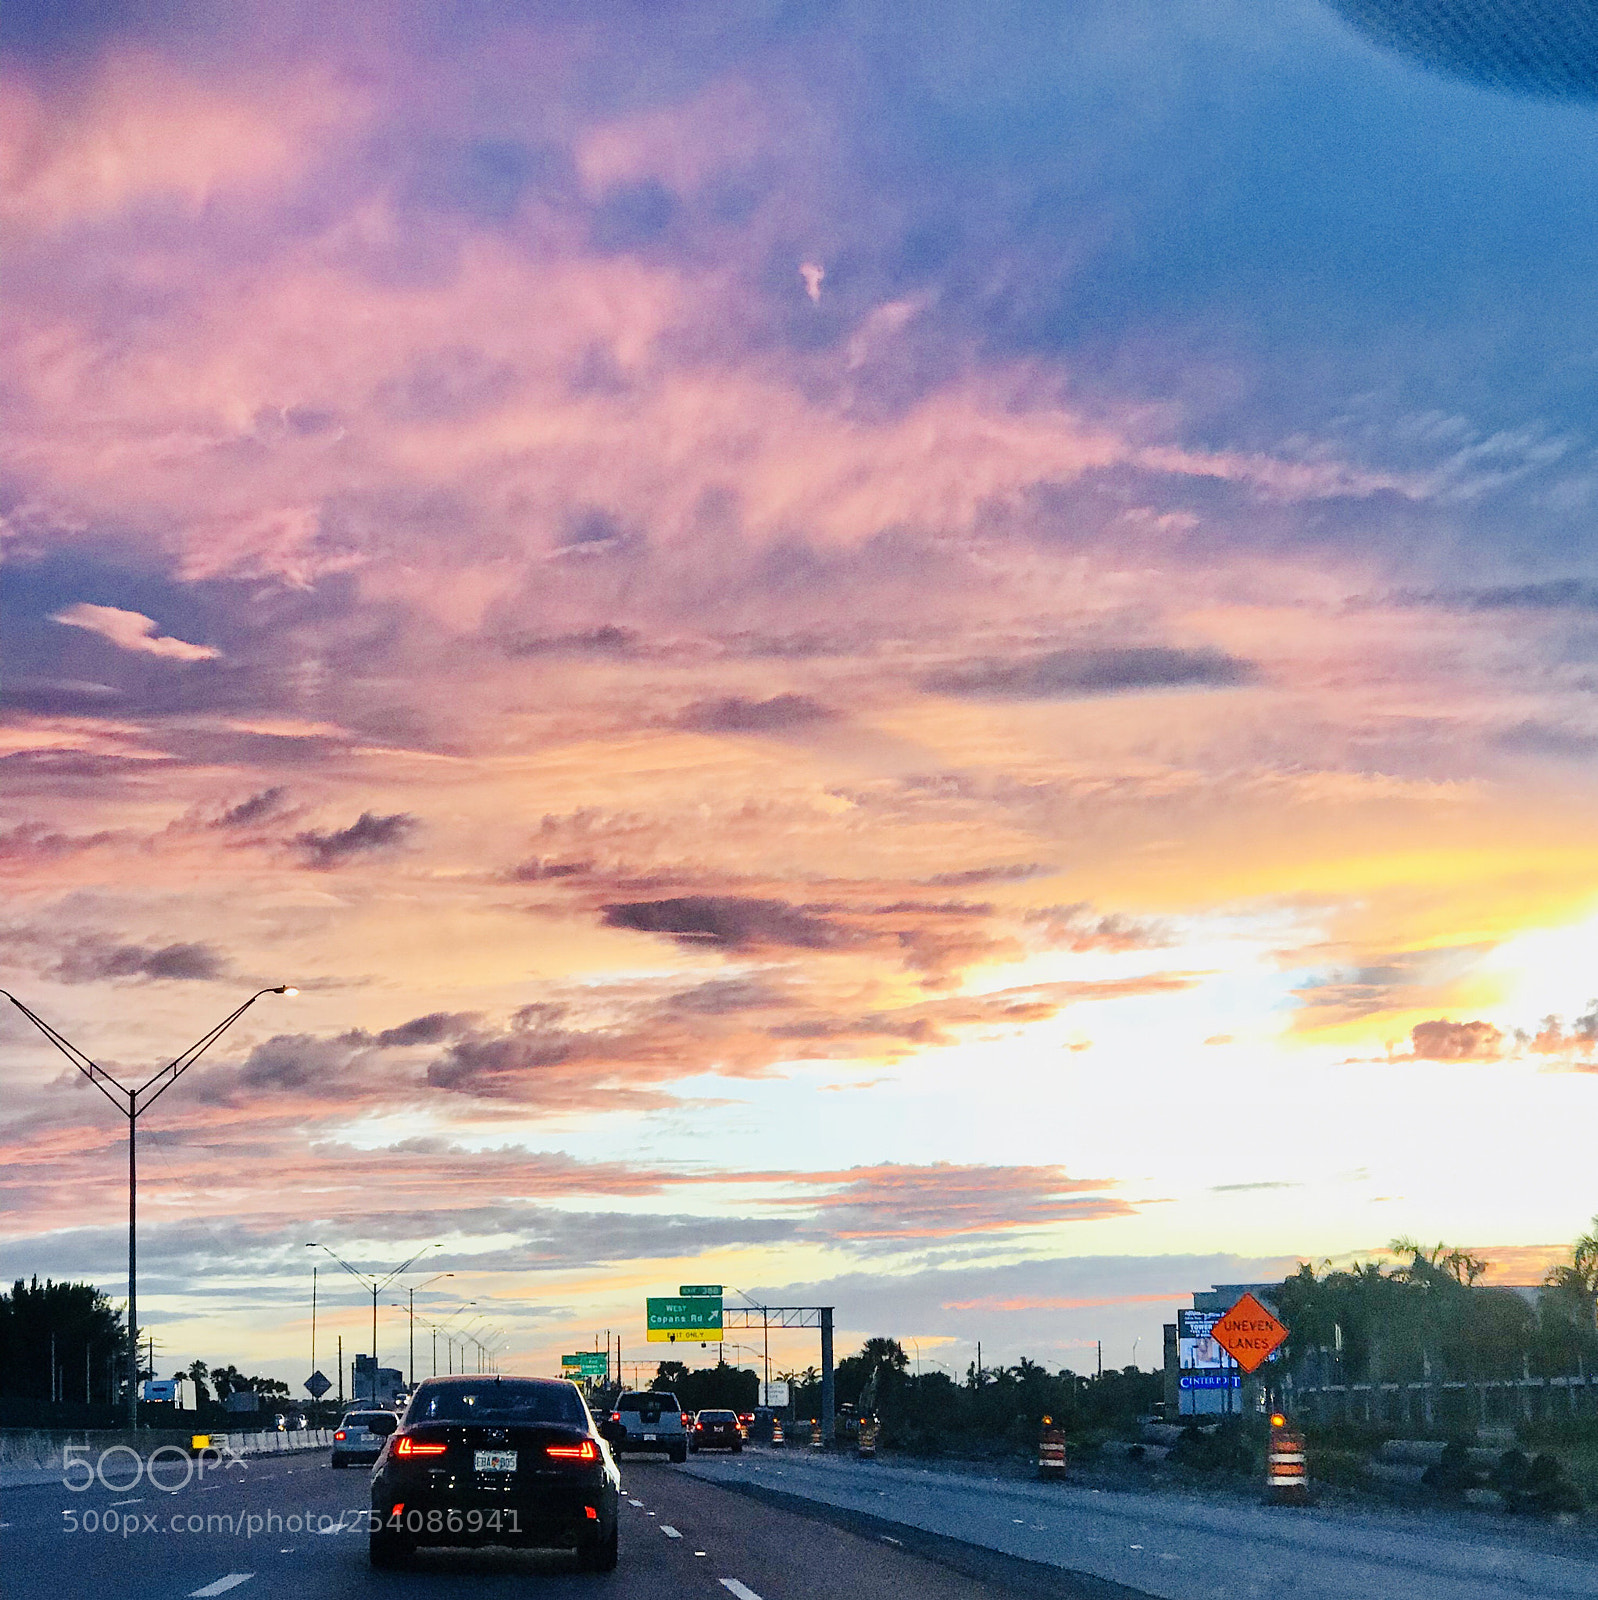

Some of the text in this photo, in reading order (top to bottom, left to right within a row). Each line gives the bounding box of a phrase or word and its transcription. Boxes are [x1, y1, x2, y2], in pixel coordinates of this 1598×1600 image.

[666, 1304, 687, 1312] WEST
[650, 1314, 703, 1323] Copans Rd
[1224, 1320, 1273, 1331] UNEVEN
[1229, 1338, 1269, 1349] LANES
